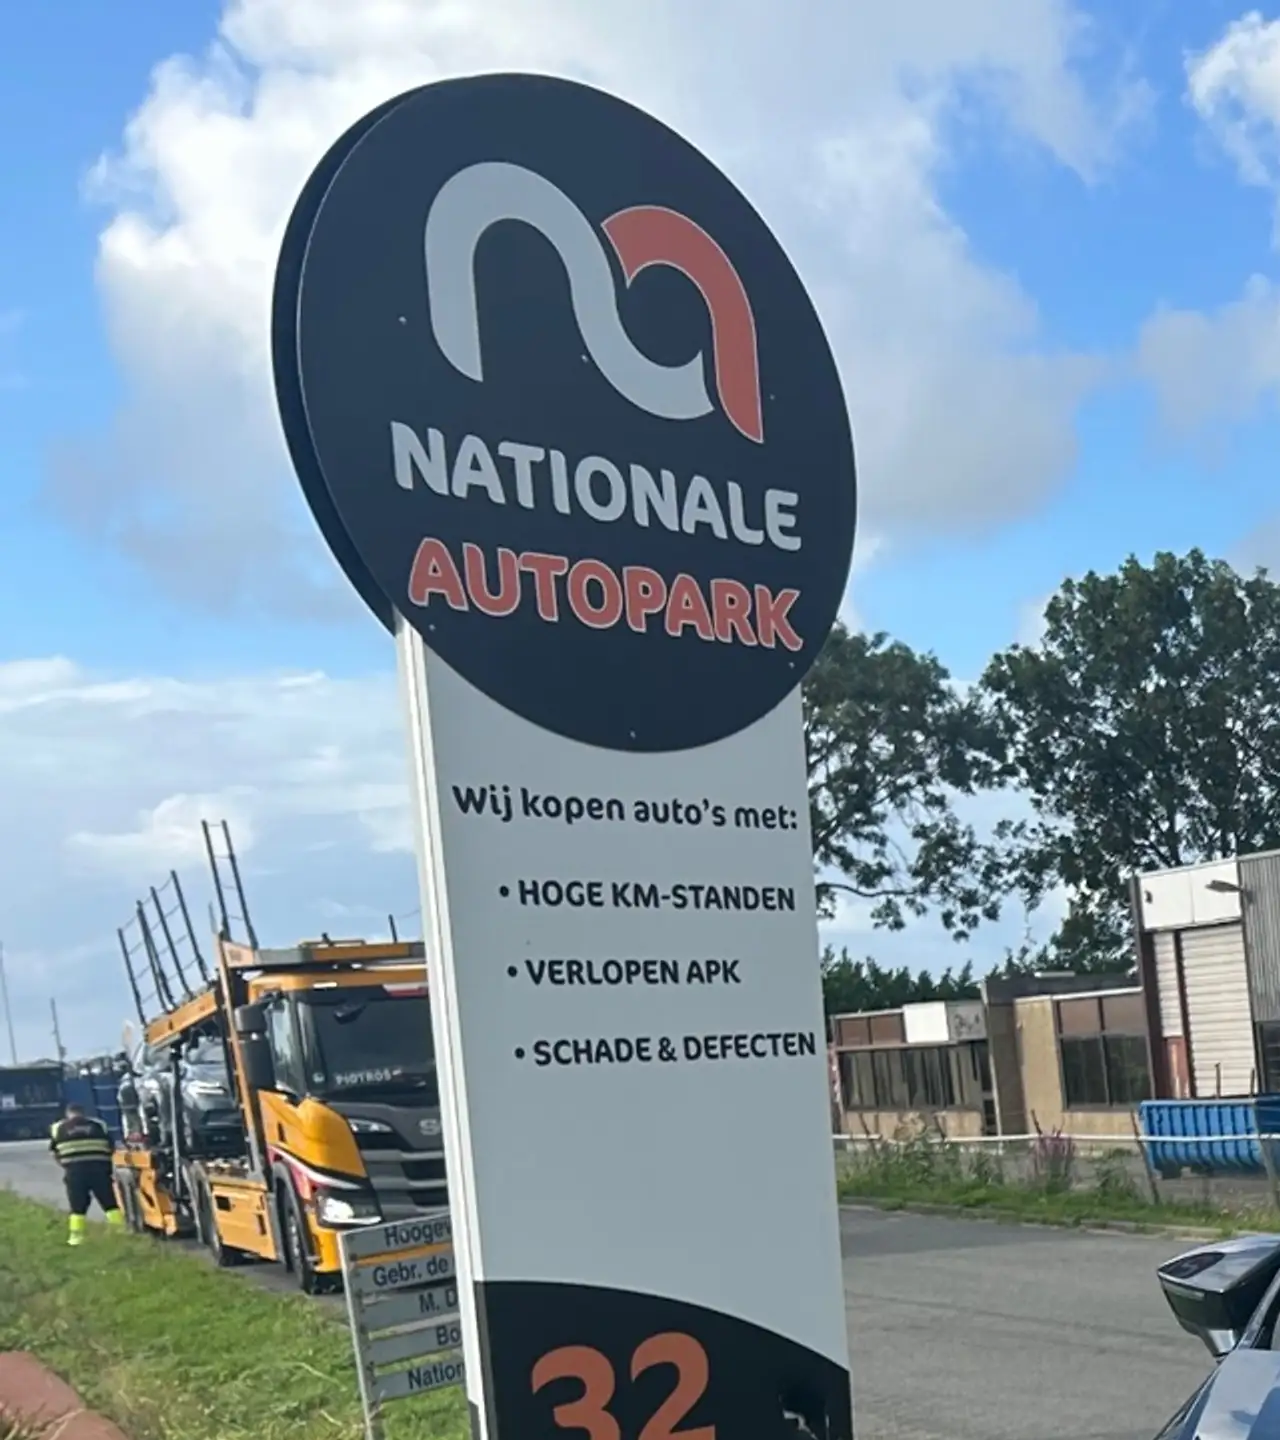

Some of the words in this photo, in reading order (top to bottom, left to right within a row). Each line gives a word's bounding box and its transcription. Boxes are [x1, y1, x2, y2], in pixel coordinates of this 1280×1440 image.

[391, 421, 801, 551] NATIONALE
[408, 537, 804, 652] AUTOPARK
[452, 784, 512, 823] Wij
[520, 787, 625, 825] kopen
[634, 798, 726, 827] auto's
[734, 804, 798, 830] met:
[518, 879, 604, 907] HOGE
[611, 882, 796, 911] KM-STANDEN
[525, 959, 680, 985] VERLOPEN
[686, 959, 741, 984] APK
[533, 1036, 652, 1066] SCHADE
[658, 1036, 677, 1062] &
[684, 1031, 817, 1060] DEFECTEN
[373, 1260, 422, 1287] Gebr.
[427, 1256, 449, 1275] de
